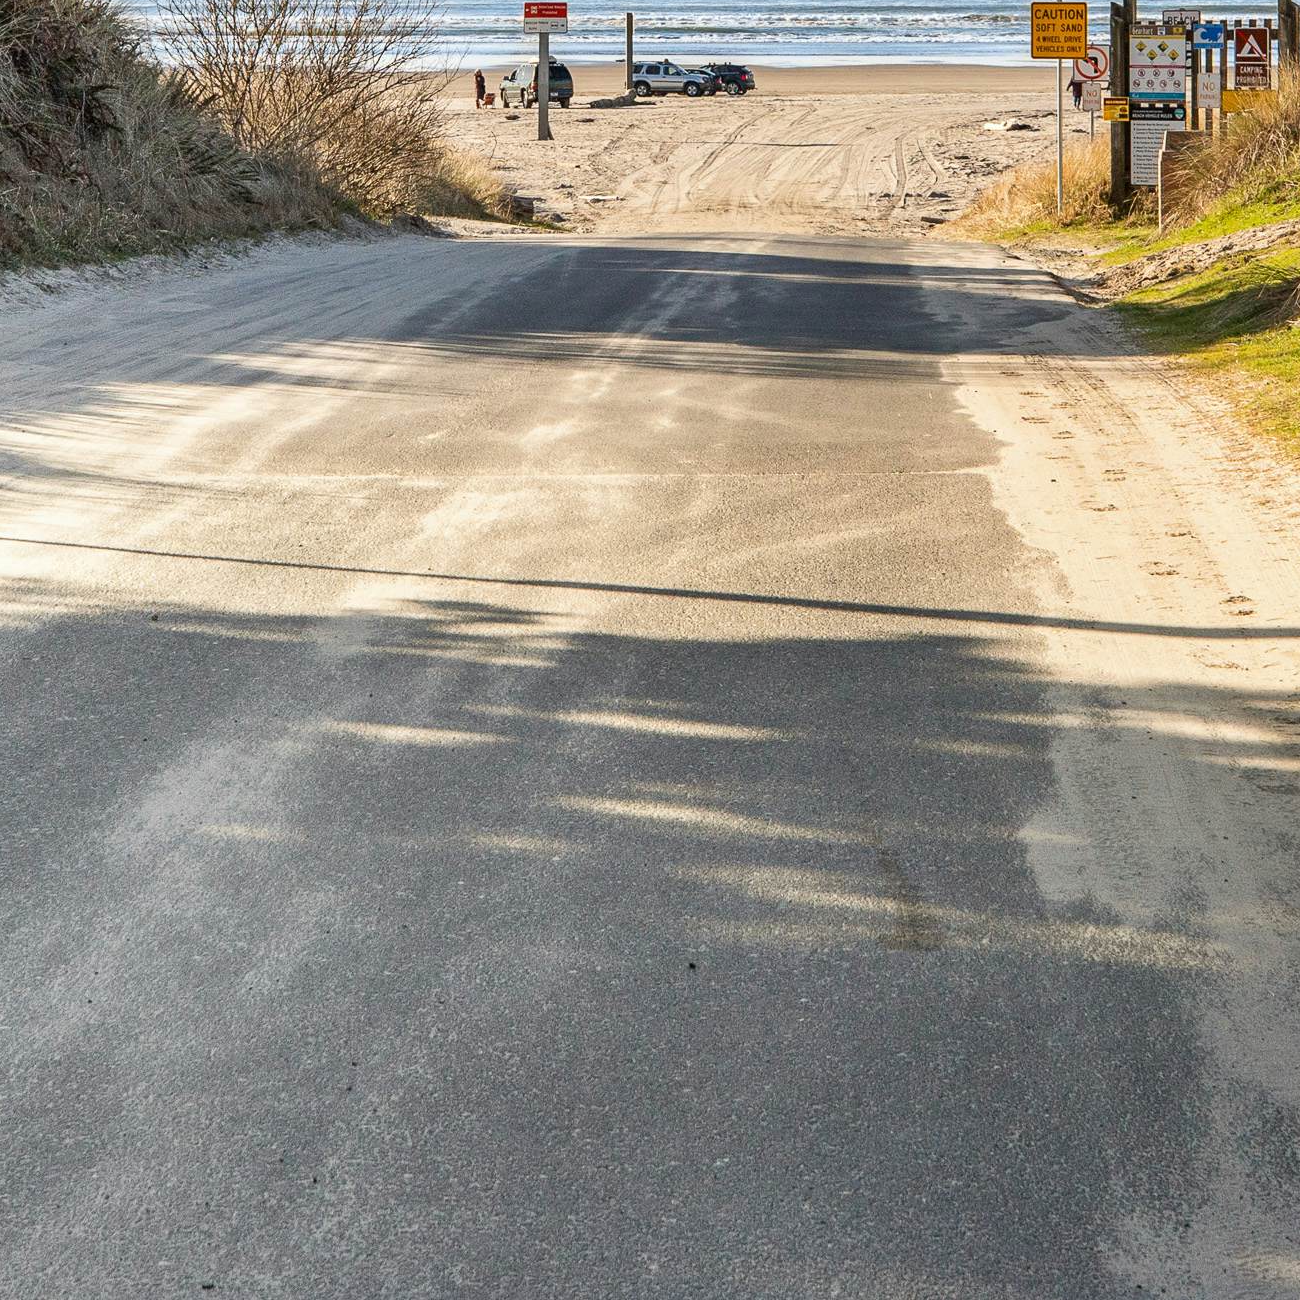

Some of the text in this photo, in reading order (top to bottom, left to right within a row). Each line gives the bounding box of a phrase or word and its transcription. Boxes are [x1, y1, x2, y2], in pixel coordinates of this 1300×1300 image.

[1035, 9, 1084, 20] CAUTION
[1036, 23, 1083, 32] SOFT SAND
[1240, 66, 1263, 74] CAMPING
[1203, 82, 1215, 92] NO
